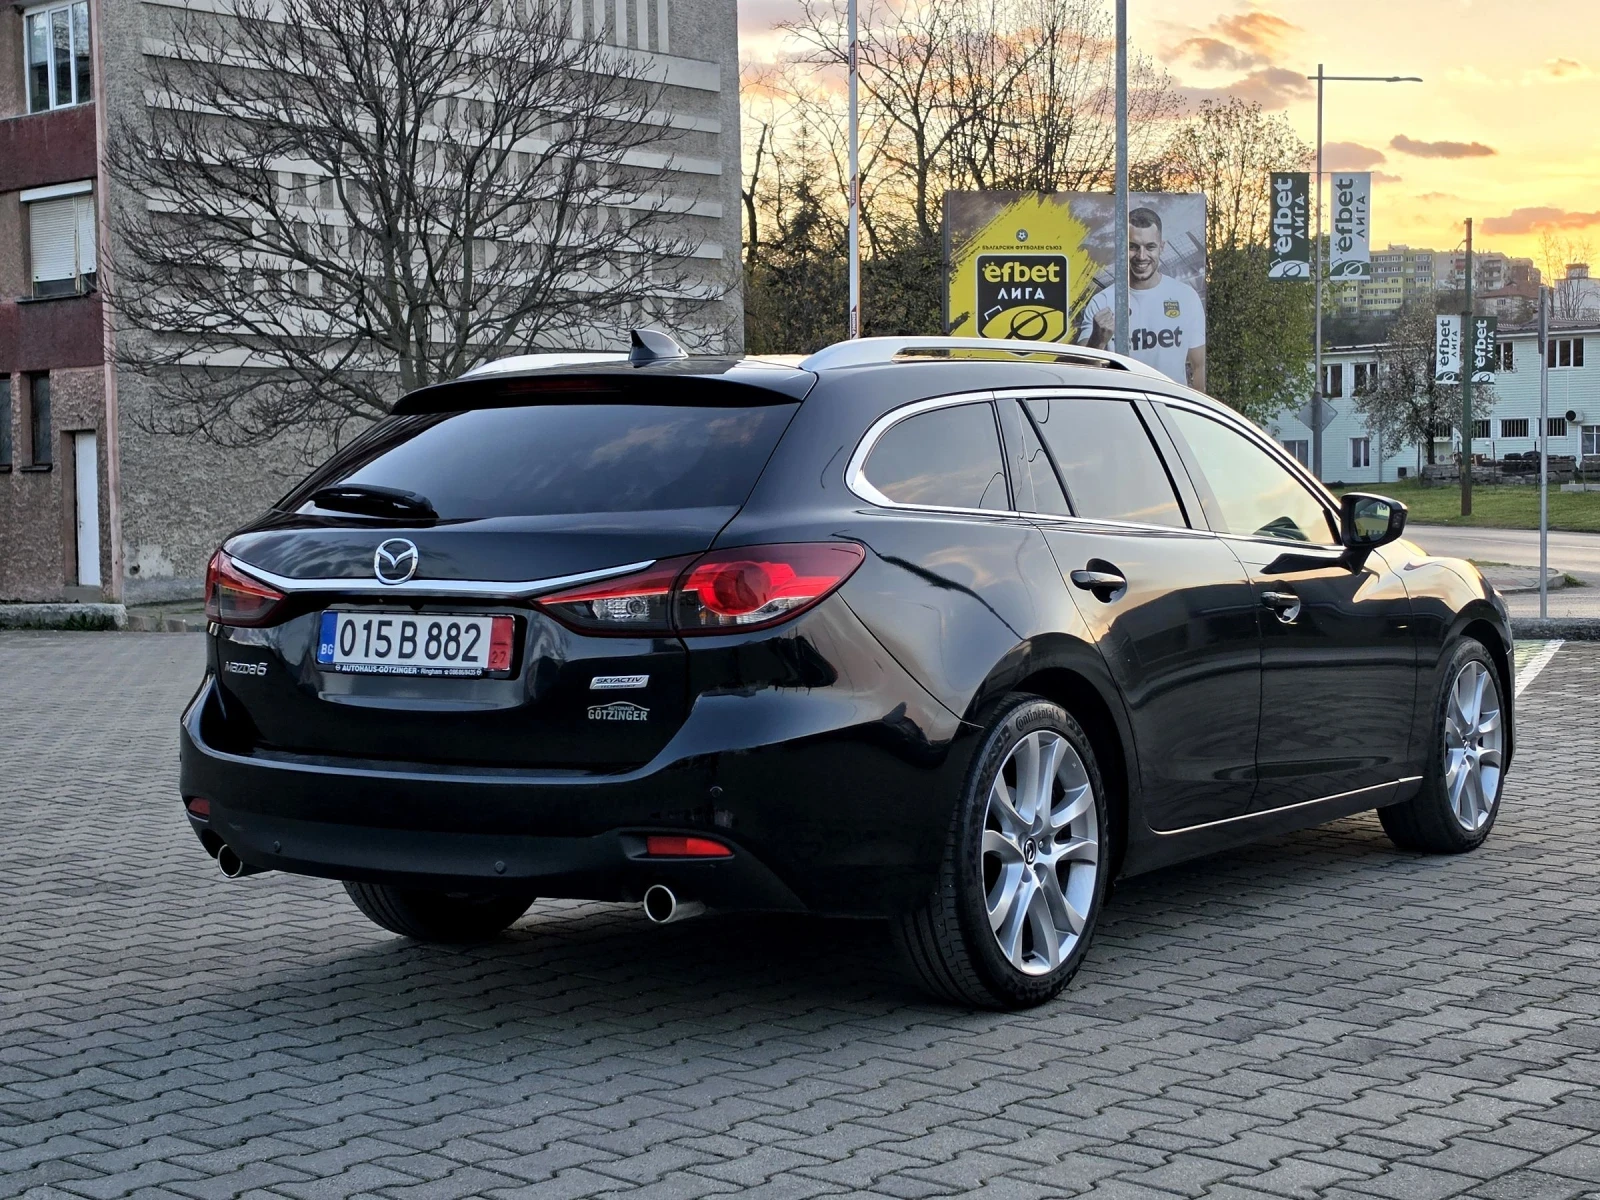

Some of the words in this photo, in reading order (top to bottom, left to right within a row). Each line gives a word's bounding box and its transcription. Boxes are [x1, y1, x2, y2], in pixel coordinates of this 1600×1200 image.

[997, 287, 1045, 300] ЛИГА
[1129, 326, 1183, 351] fbet
[321, 643, 333, 655] BG
[1016, 708, 1055, 732] Continental
